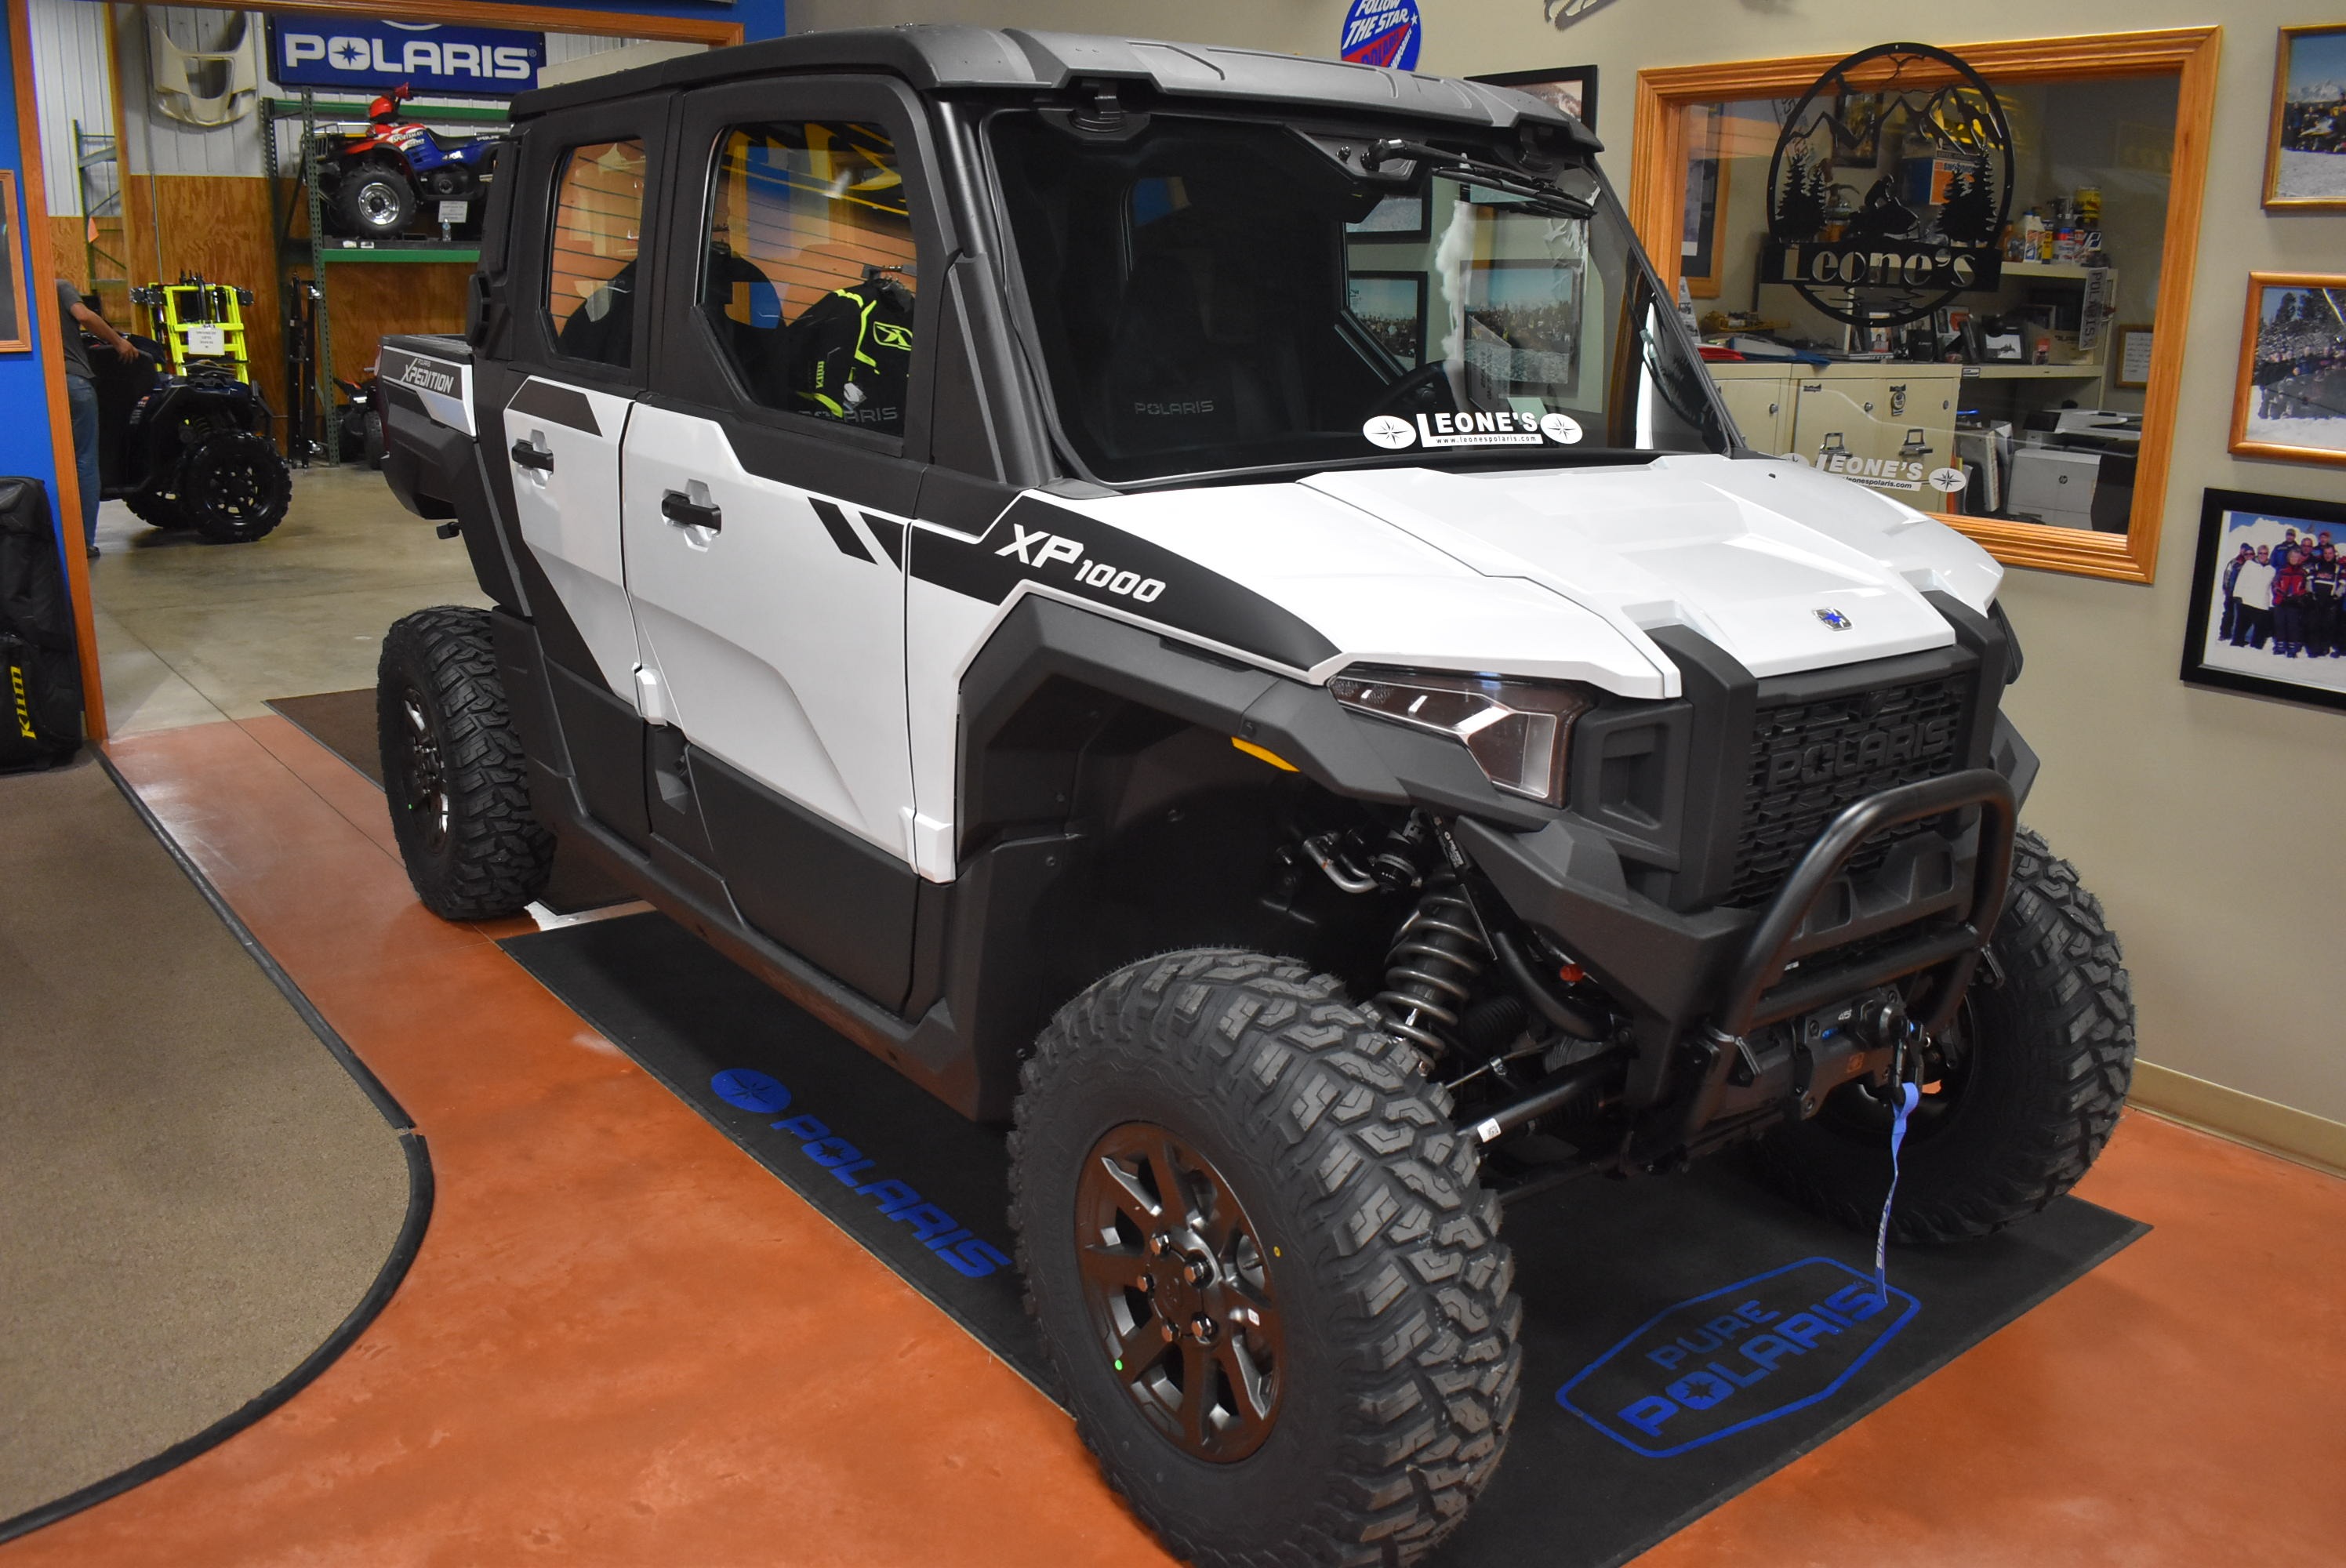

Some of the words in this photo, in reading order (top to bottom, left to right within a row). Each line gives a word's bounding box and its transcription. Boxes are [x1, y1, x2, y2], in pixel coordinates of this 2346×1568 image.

[1342, 16, 1379, 50] THE
[1375, 8, 1410, 34] STAR
[1782, 243, 1976, 288] Leone's
[401, 358, 454, 394] XPEDITION
[1134, 400, 1215, 415] POLARIS
[1416, 412, 1543, 448] LEONE'S
[1436, 435, 1538, 445] www.leonespolaris.com
[994, 523, 1084, 568] XP
[1073, 559, 1167, 603] 1000
[1767, 717, 1951, 793] POLARIS
[770, 1113, 1013, 1279] POLARIS
[1646, 1299, 1781, 1370] PURE
[1617, 1281, 1887, 1437] POLARIS
